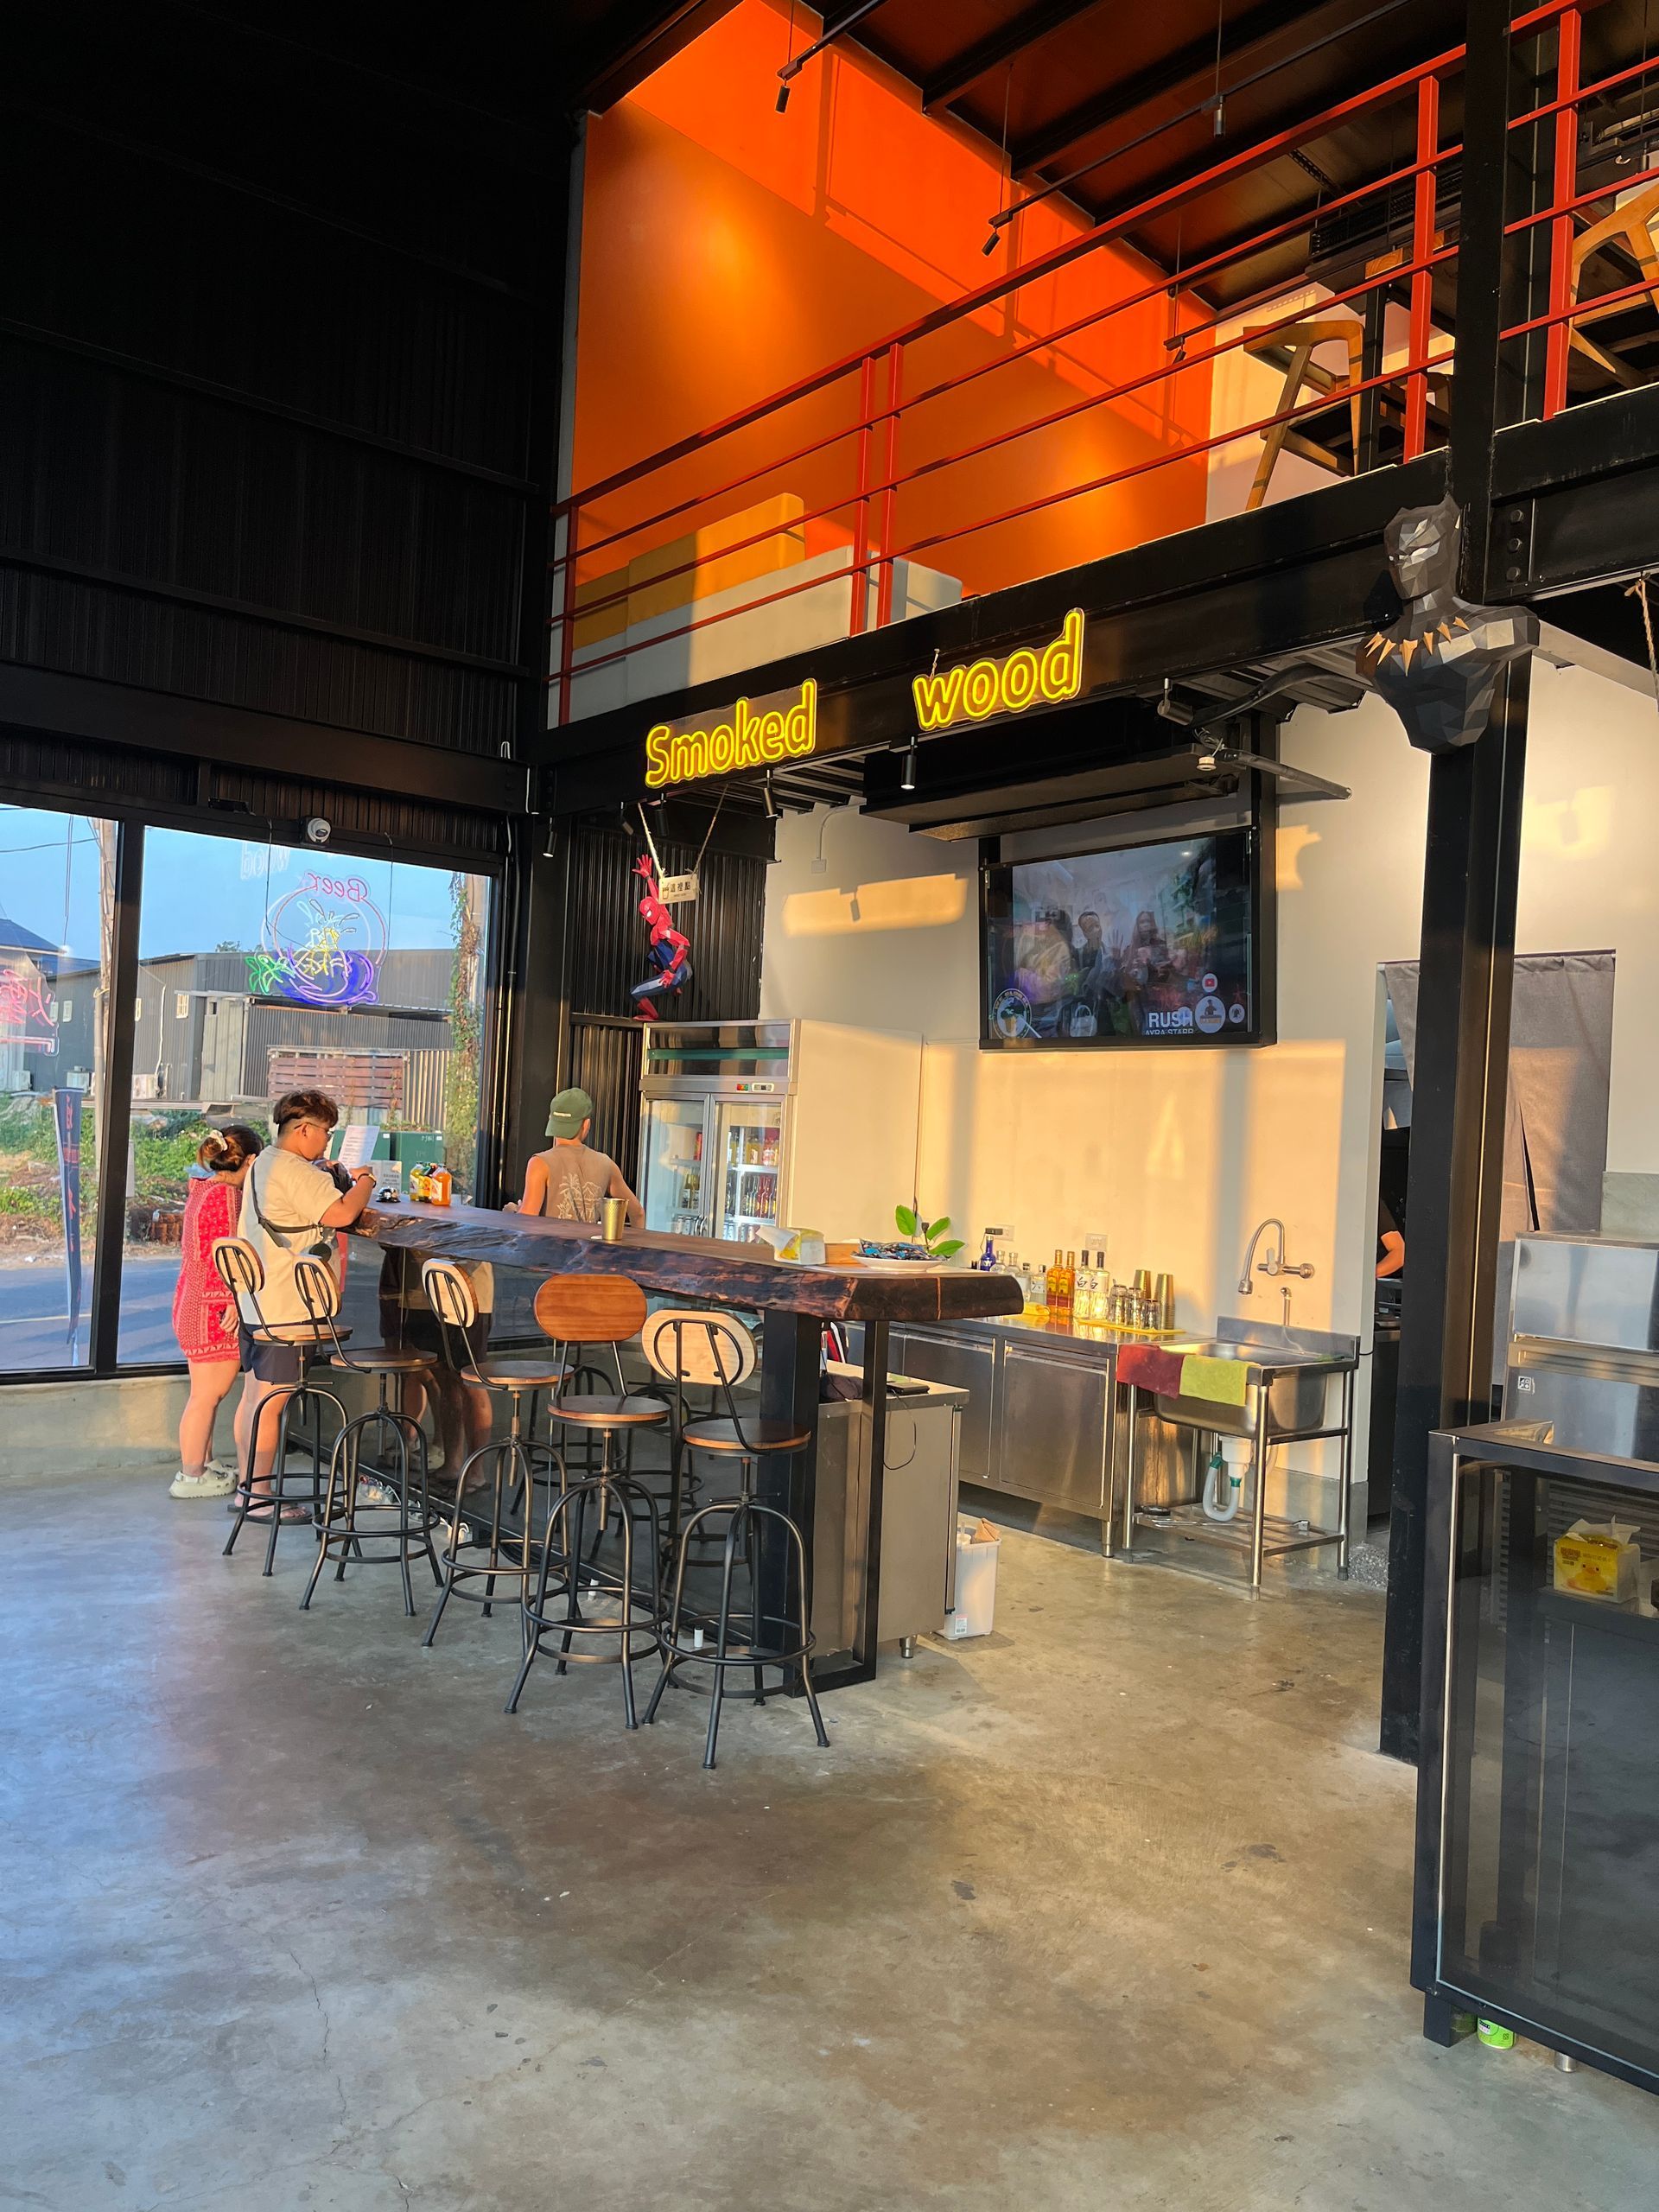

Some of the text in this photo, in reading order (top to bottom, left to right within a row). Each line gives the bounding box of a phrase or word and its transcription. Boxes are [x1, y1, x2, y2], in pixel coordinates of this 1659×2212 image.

[646, 610, 1083, 786] Smoked wood
[1148, 1012, 1192, 1027] RUSH
